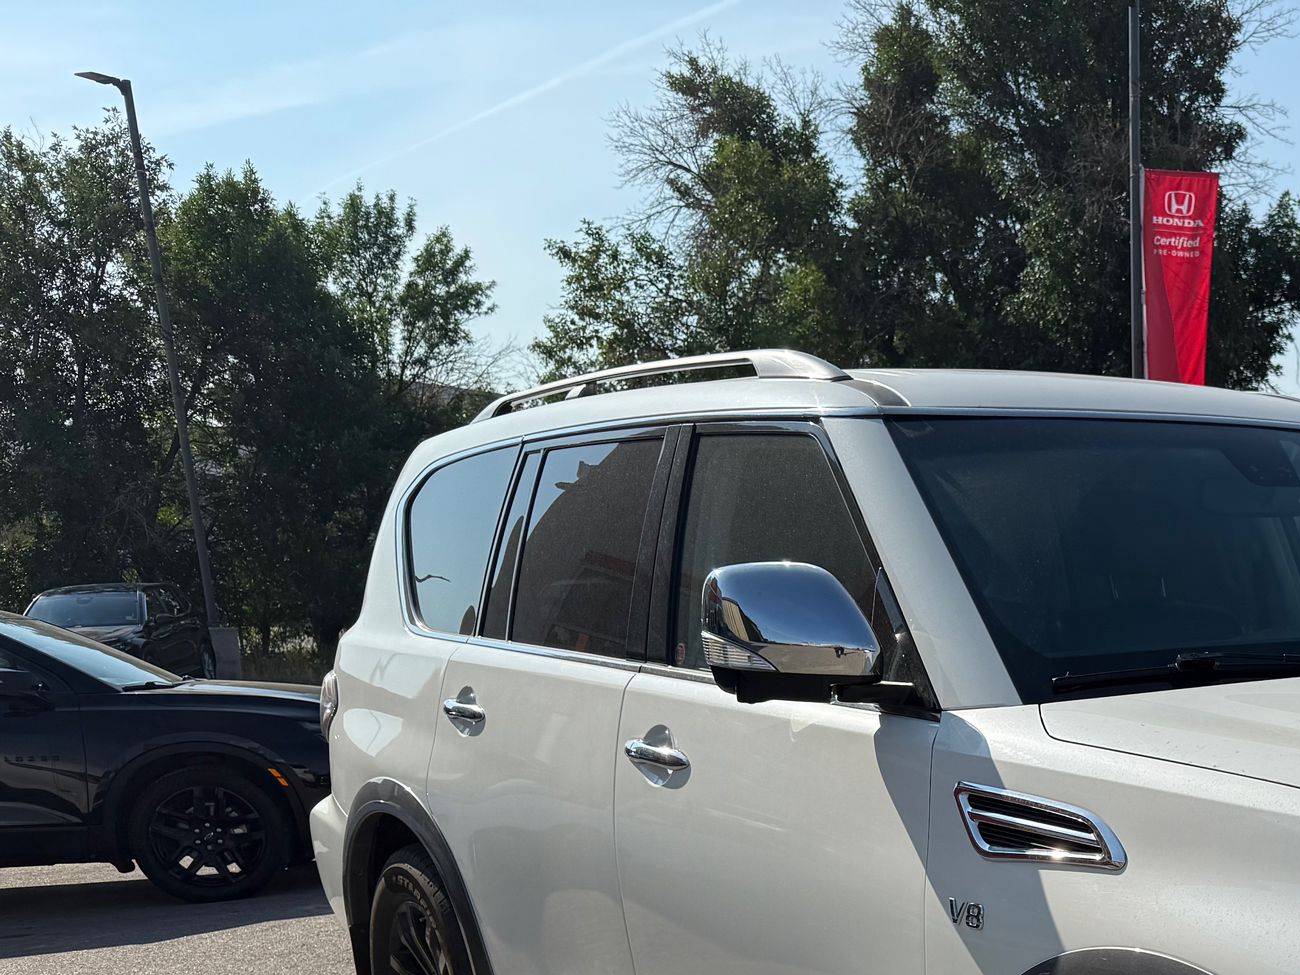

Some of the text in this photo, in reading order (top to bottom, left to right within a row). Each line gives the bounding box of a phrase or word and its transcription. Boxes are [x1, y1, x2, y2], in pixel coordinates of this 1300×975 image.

[1152, 216, 1204, 227] HONDA
[1154, 236, 1200, 249] Certified
[949, 897, 984, 929] V8
